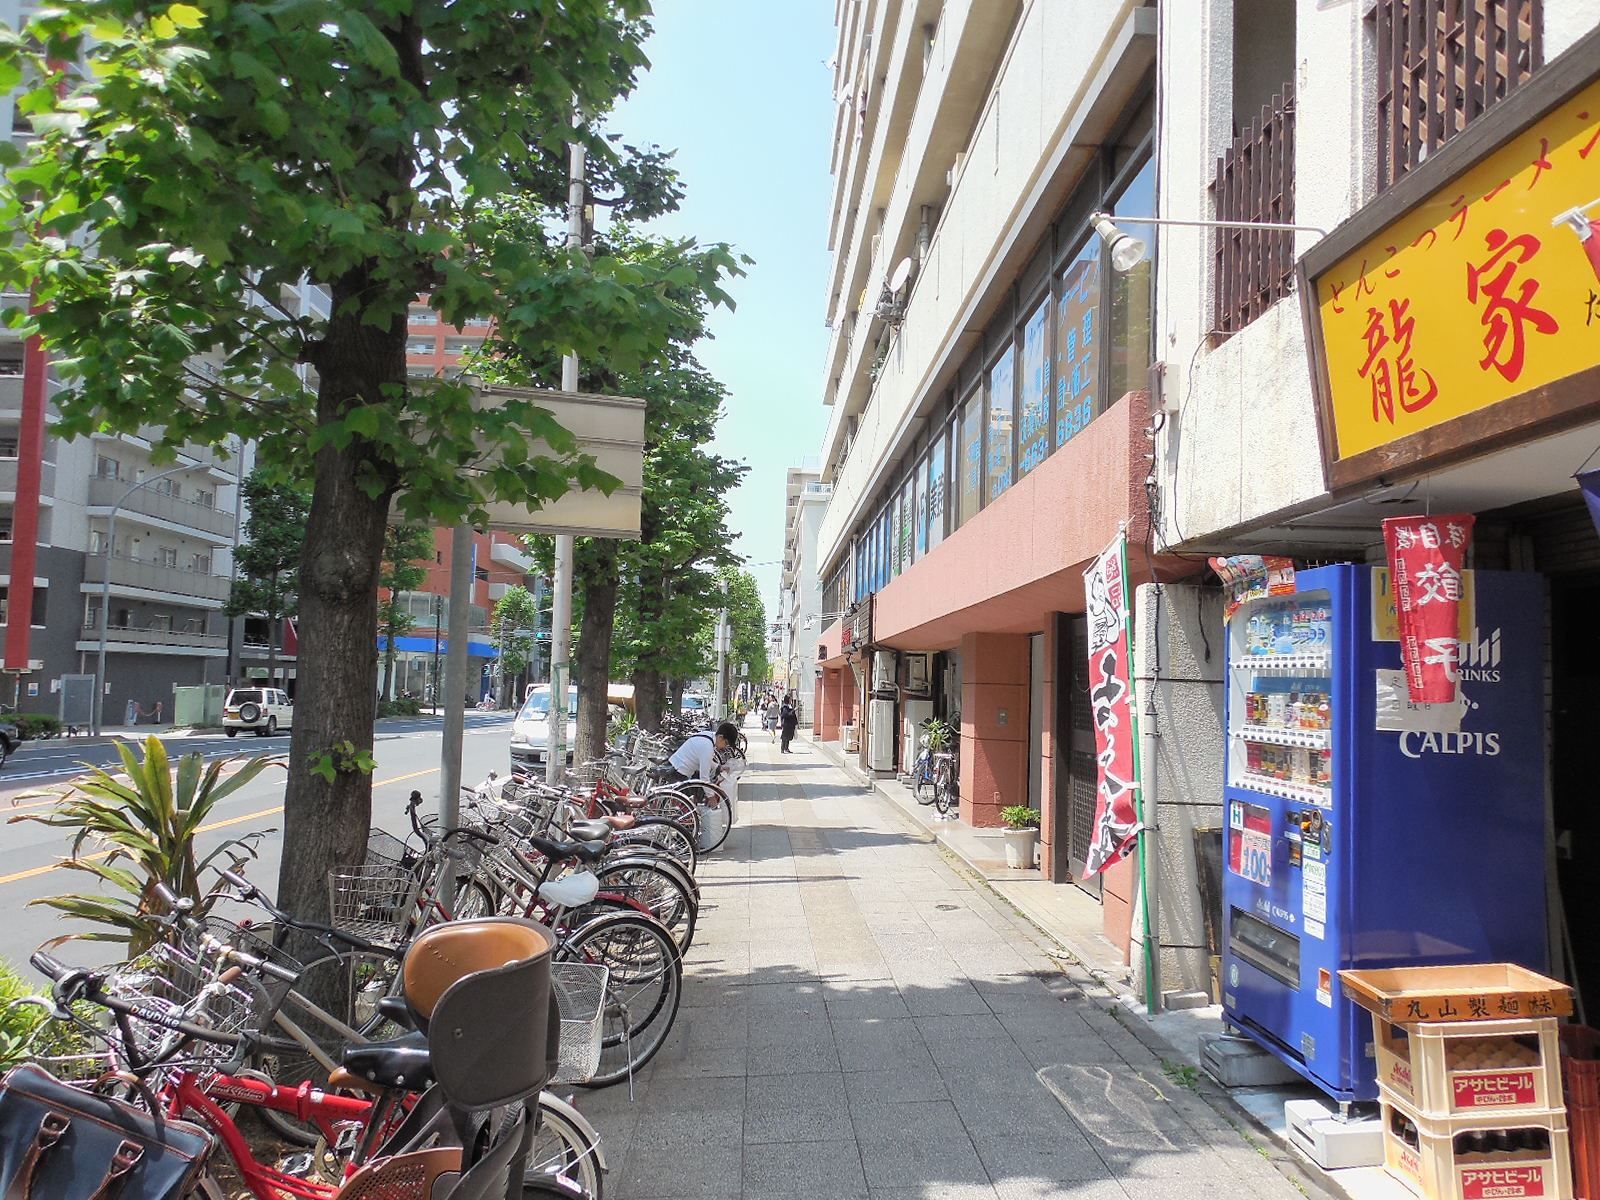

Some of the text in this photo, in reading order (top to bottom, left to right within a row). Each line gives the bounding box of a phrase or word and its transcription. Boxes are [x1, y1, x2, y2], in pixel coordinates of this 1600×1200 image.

[1358, 228, 1560, 426] 龍家
[1456, 669, 1501, 682] RINKS
[1399, 731, 1501, 758] CALPIS
[1454, 1076, 1533, 1093] アサヒビール
[1463, 1169, 1542, 1186] アサヒビール
